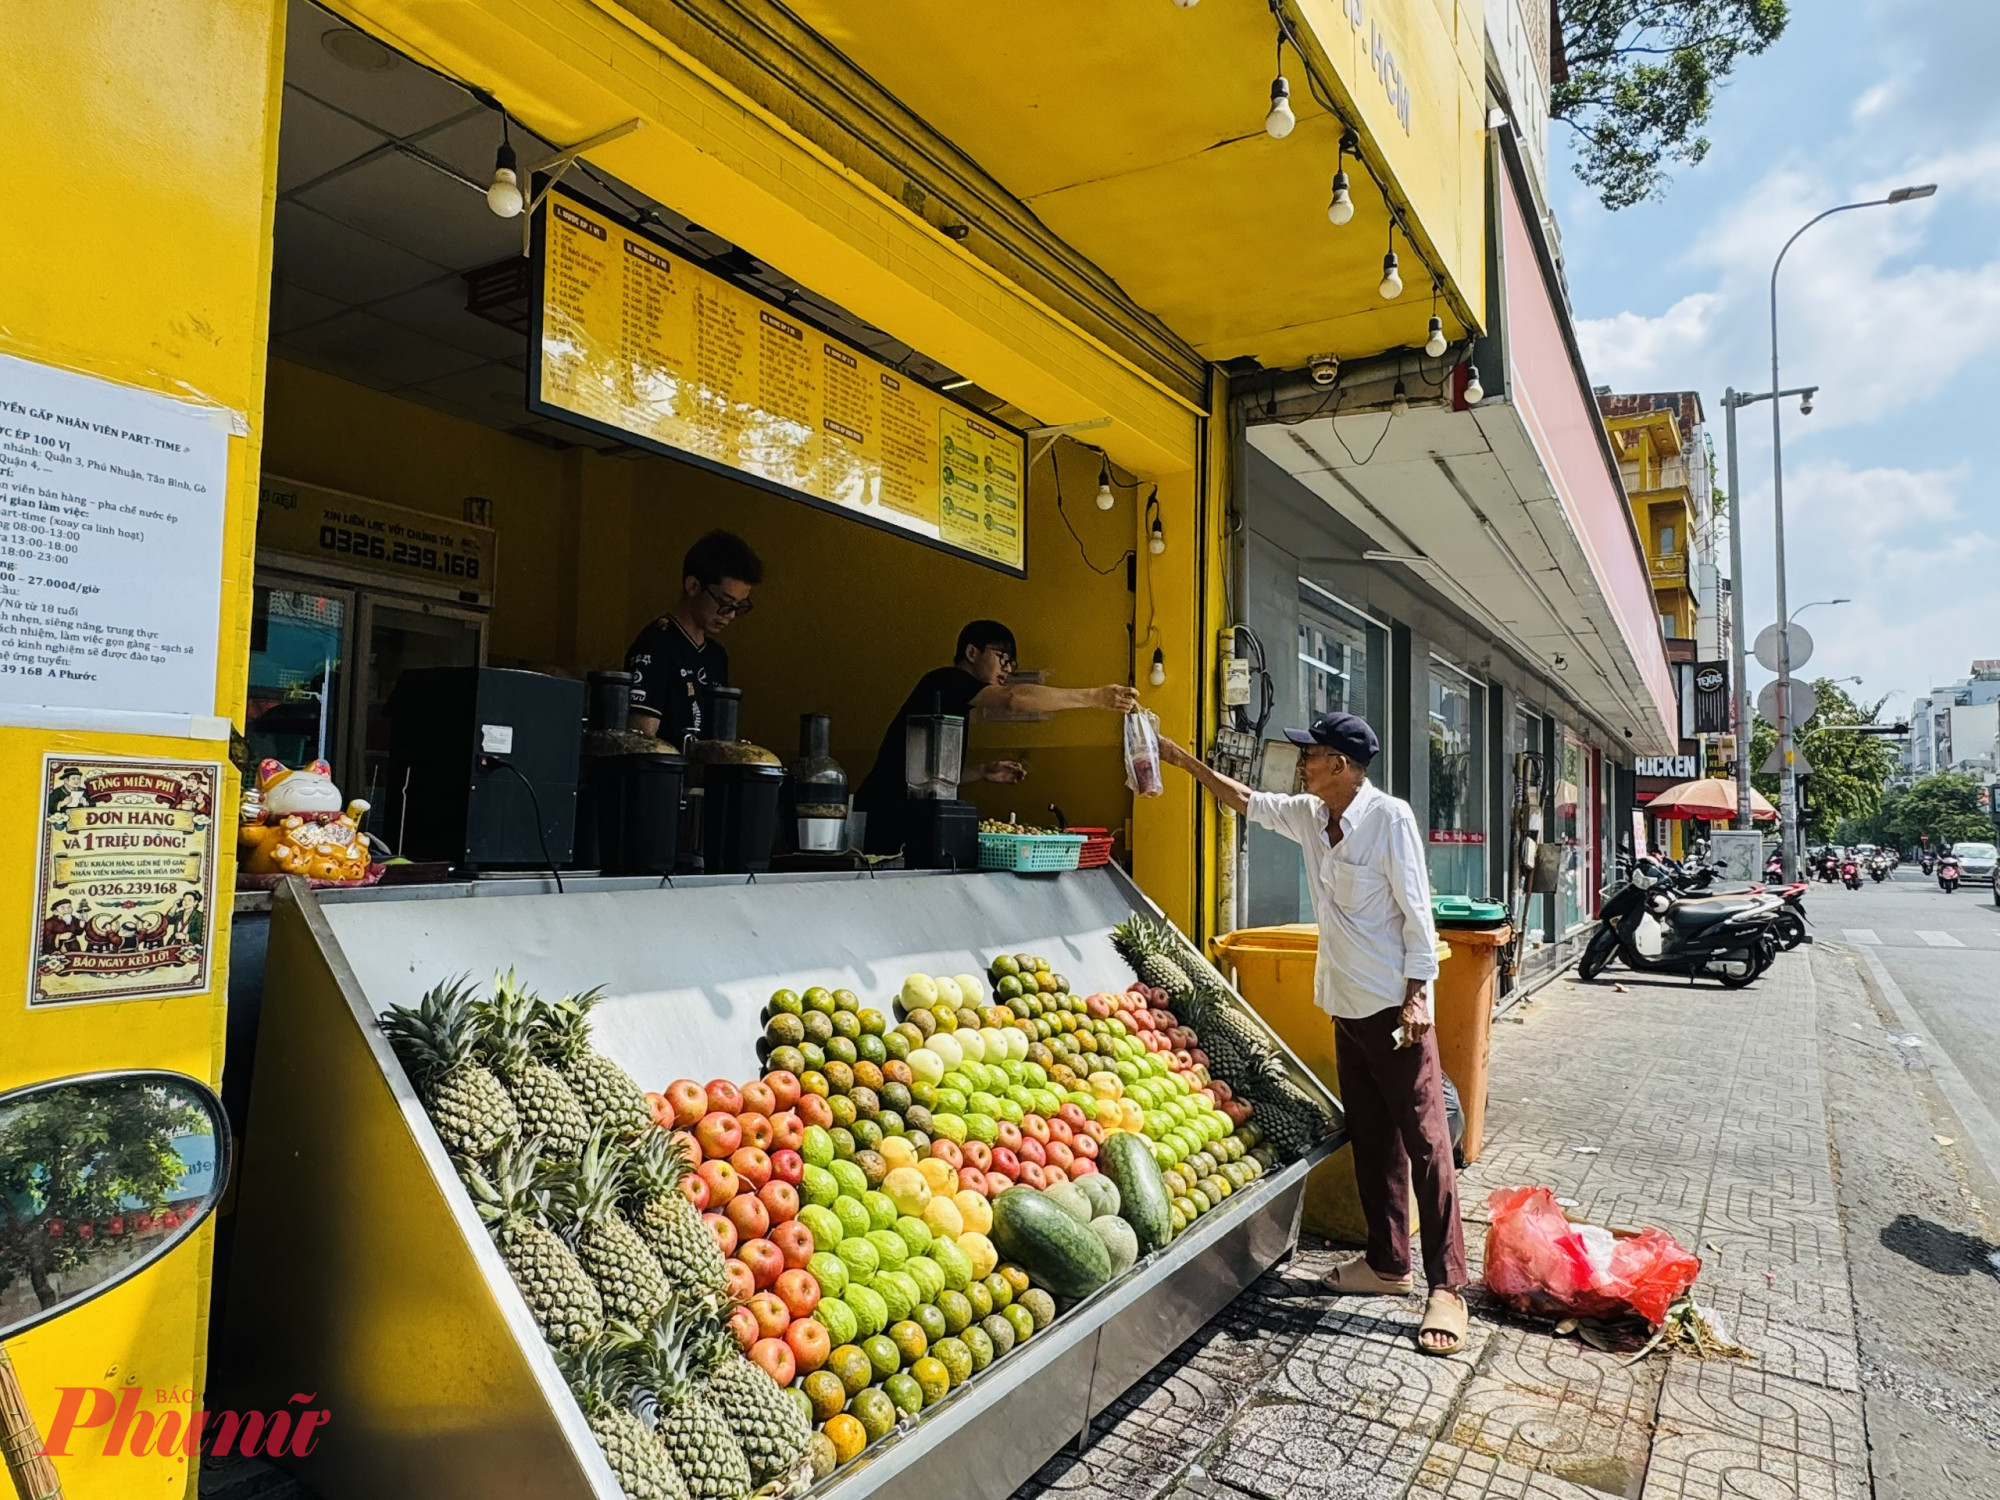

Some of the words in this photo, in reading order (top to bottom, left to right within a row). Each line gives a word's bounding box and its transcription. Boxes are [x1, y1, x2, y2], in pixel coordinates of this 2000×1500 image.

[29, 408, 54, 421] GẤP
[56, 415, 90, 430] NHÂN
[93, 423, 119, 438] VIÊN
[121, 430, 181, 452] PART-TIME
[15, 428, 31, 441] ÉP
[34, 434, 56, 448] 100
[58, 440, 71, 453] VỊ
[3, 442, 42, 458] nhánh:
[45, 450, 73, 464] Quận
[75, 457, 85, 468] 3,
[87, 460, 107, 472] Phú
[109, 464, 145, 482] Nhuận,
[146, 473, 165, 485] Tân
[168, 477, 192, 492] Bình,
[194, 483, 206, 494] Gò
[30, 461, 41, 472] 4,
[10, 496, 36, 509] gian
[38, 500, 60, 512] làm
[63, 506, 90, 518] việc:
[12, 483, 35, 496] viên
[38, 486, 59, 499] bán
[60, 491, 87, 508] hàng
[97, 500, 117, 512] pha
[119, 502, 137, 515] chế
[138, 509, 164, 520] nước
[166, 512, 178, 524] ép
[12, 521, 81, 542] 08:00-13:00
[50, 516, 80, 530] (xoay
[82, 523, 94, 532] ca
[96, 524, 116, 536] linh
[118, 528, 144, 542] hoạt)
[11, 534, 79, 554] 13:00-18:00
[320, 524, 480, 580] 0326.239.168
[1, 546, 69, 565] 18:00-23:00
[28, 576, 101, 595] 27.000đ/giờ
[25, 600, 38, 612] từ
[41, 603, 54, 614] 18
[57, 606, 79, 617] tuổi
[12, 612, 42, 626] nhẹn,
[45, 617, 74, 630] siêng
[76, 620, 104, 634] năng,
[106, 625, 134, 638] trung
[136, 627, 160, 640] thực
[20, 626, 58, 640] nhiệm,
[60, 630, 80, 642] làm
[83, 634, 104, 646] việc
[106, 638, 124, 648] gọn
[126, 638, 151, 652] gàng
[160, 643, 182, 654] sạch
[184, 644, 194, 655] sẽ
[2, 638, 15, 648] có
[18, 639, 42, 651] kinh
[46, 642, 85, 656] nghiệm
[88, 646, 100, 656] sẽ
[102, 648, 128, 660] được
[130, 651, 148, 662] đào
[150, 654, 166, 664] tạo
[12, 652, 35, 665] ứng
[38, 655, 72, 668] tuyển:
[20, 666, 42, 676] 168
[48, 669, 56, 678] A
[59, 670, 98, 682] Phước
[1696, 673, 1724, 688] TEXAS
[90, 776, 120, 792] TẶNG
[156, 780, 175, 794] PHÍ
[86, 812, 123, 826] ĐƠN
[127, 812, 174, 826] HÀNG
[63, 838, 81, 850] VÀ
[84, 832, 94, 850] 1
[96, 832, 140, 850] TRIỆU
[143, 830, 186, 848] ĐỒNG!
[69, 888, 86, 897] QUA
[88, 882, 178, 897] 0326.239.168
[72, 955, 96, 968] BÁO
[98, 958, 126, 968] NGAY
